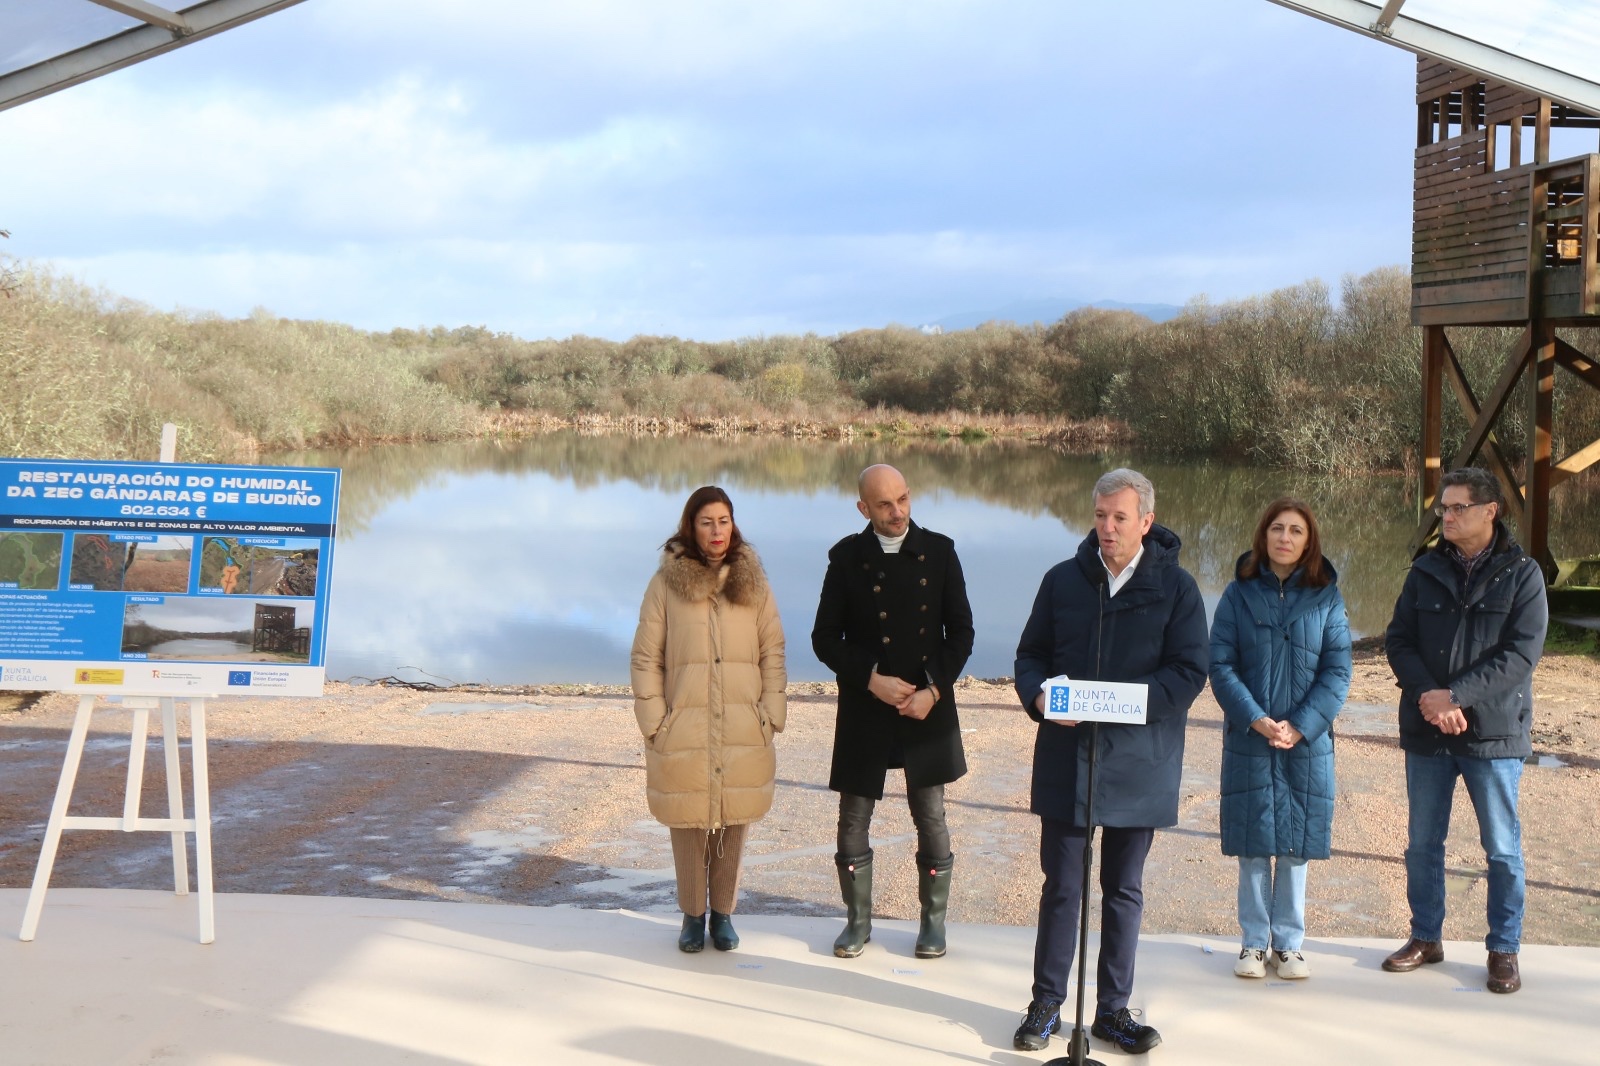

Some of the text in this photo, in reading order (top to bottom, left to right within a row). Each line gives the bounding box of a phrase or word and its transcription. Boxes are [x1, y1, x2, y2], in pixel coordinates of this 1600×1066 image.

[18, 471, 312, 491] RESTAURACIÓN DO HUMIDAL
[6, 486, 321, 506] DA ZEC GÁNDARAS DE BUDIÑO
[120, 504, 207, 518] 802.634 €
[14, 518, 78, 526] RECUPERACIÓN
[1074, 689, 1116, 701] XUNTA
[1073, 702, 1142, 714] DE GALICIA
